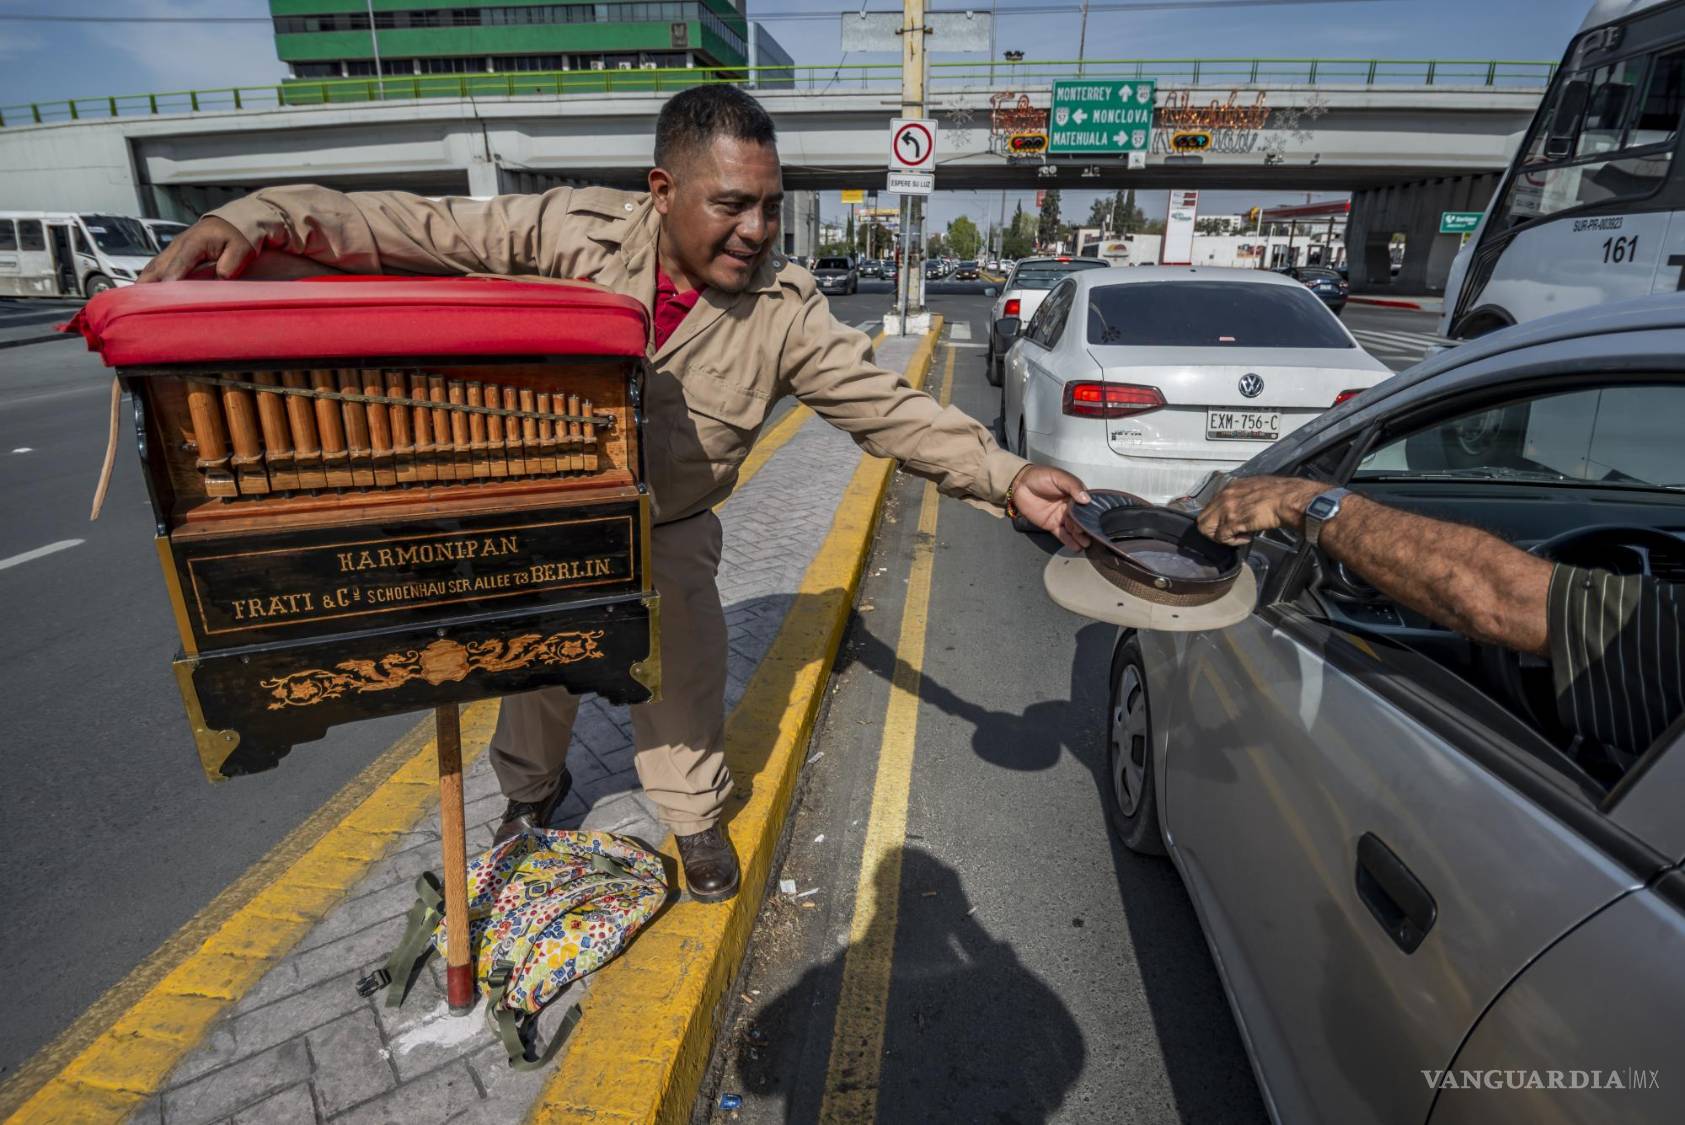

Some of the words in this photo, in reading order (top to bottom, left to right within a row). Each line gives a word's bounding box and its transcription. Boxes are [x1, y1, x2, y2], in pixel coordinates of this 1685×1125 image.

[1056, 86, 1112, 101] MONTERREY
[1092, 109, 1148, 123] MONCLOVA
[1052, 131, 1108, 145] MATEHUALA
[890, 180, 912, 188] ESPERE
[920, 180, 930, 188] LUZ
[1602, 235, 1638, 263] 161
[1210, 413, 1278, 430] EXM-756-C
[337, 536, 519, 572] HARMONIPAN
[232, 592, 314, 620] FRATI
[474, 574, 510, 590] ALLEE
[513, 572, 529, 585] 73
